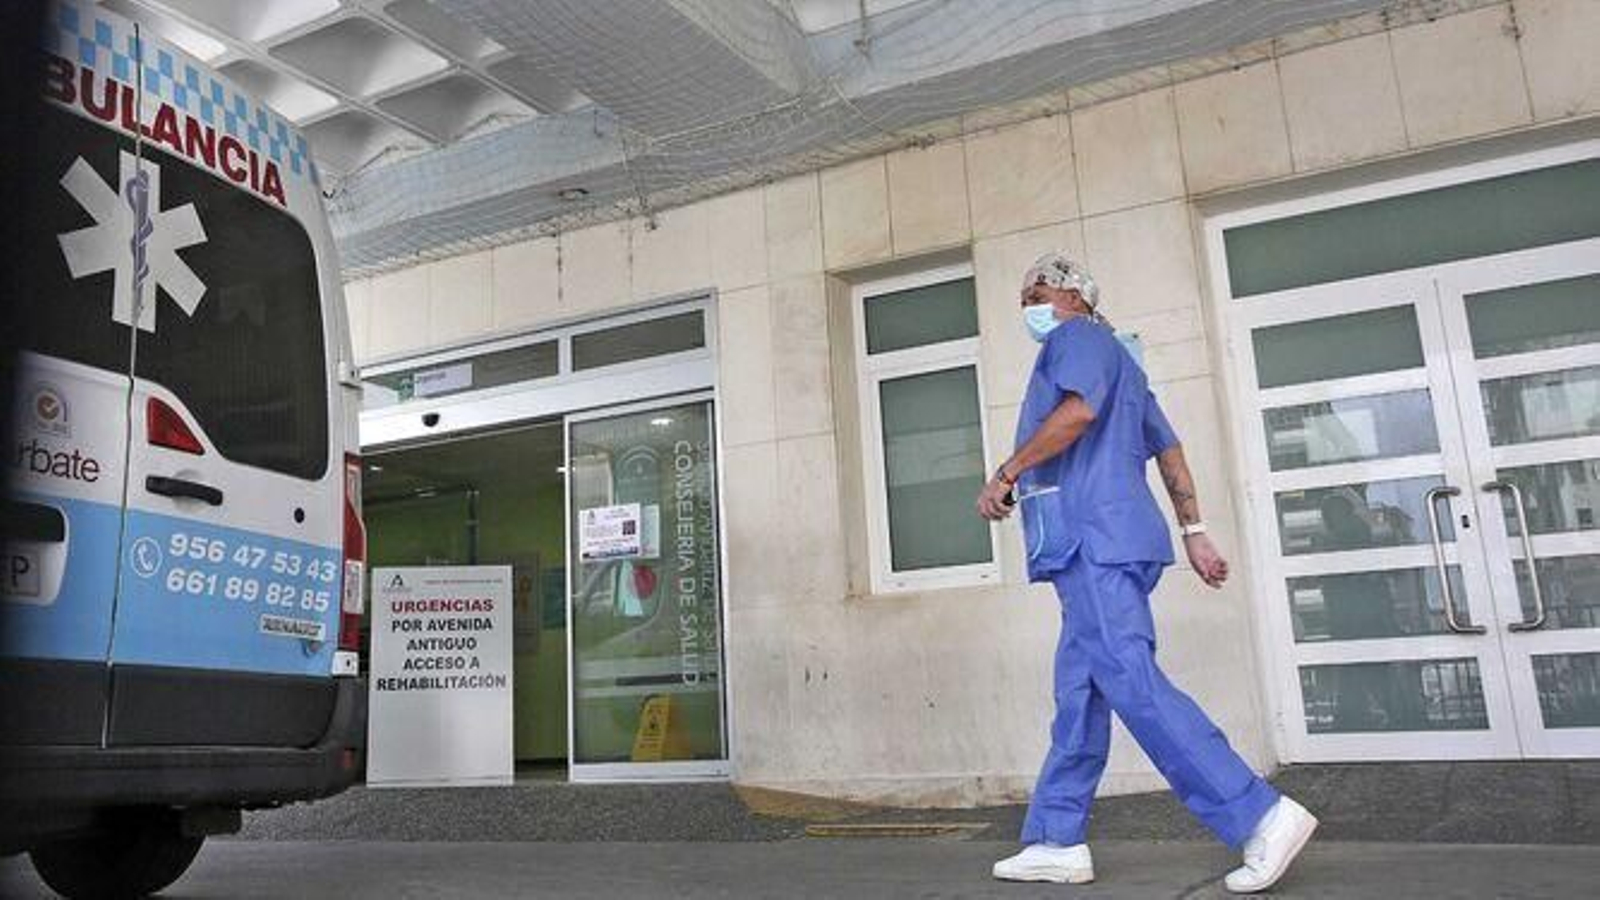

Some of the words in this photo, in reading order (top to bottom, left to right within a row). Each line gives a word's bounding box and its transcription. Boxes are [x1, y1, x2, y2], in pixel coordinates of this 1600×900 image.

[674, 440, 696, 571] CONSEJERIA
[169, 533, 227, 563] 956
[232, 545, 266, 569] 47
[271, 551, 301, 576] 53
[306, 558, 337, 582] 43
[166, 568, 217, 596] 661
[224, 576, 259, 601] 89
[265, 583, 296, 608] 82
[300, 589, 331, 612] 85
[680, 577, 698, 608] DE
[391, 599, 494, 613] URGENCIAS
[391, 619, 422, 633] POR
[427, 617, 493, 632] AVENIDA
[406, 637, 477, 651] ANTIGUO
[681, 613, 699, 686] SALUD
[403, 656, 465, 670] ACCESO
[469, 656, 480, 669] A
[376, 673, 507, 691] REHABILITACIÓN
